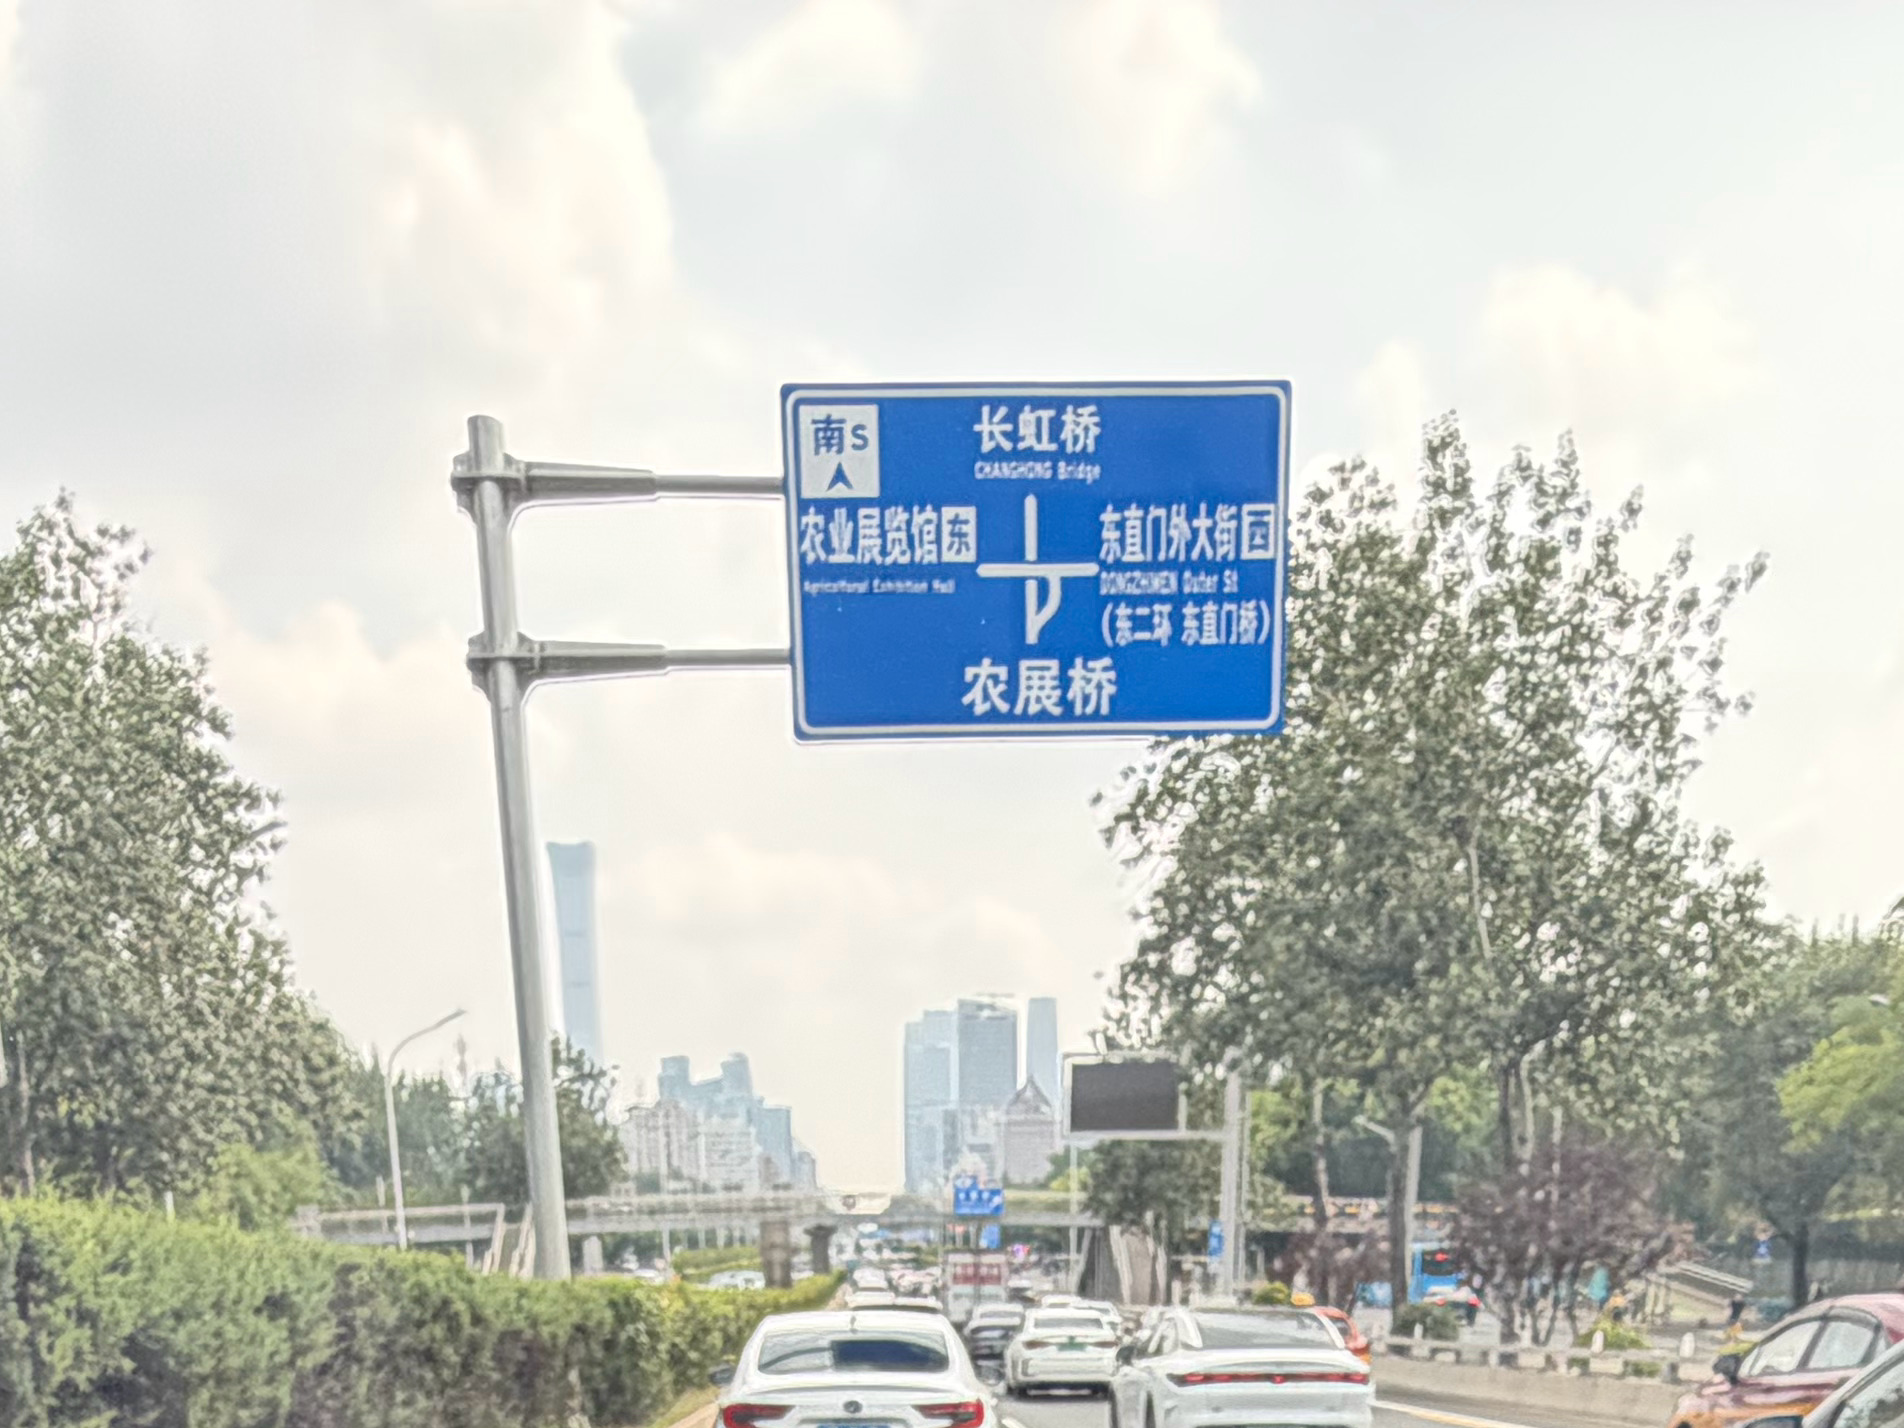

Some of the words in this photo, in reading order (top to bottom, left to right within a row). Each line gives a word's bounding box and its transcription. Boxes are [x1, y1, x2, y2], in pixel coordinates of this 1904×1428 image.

[973, 404, 1101, 454] 长虹桥
[1058, 460, 1101, 485] Bridge
[799, 504, 940, 565] 农业展览馆
[1099, 503, 1239, 563] 东直门外大街
[961, 656, 1117, 717] 农展桥
